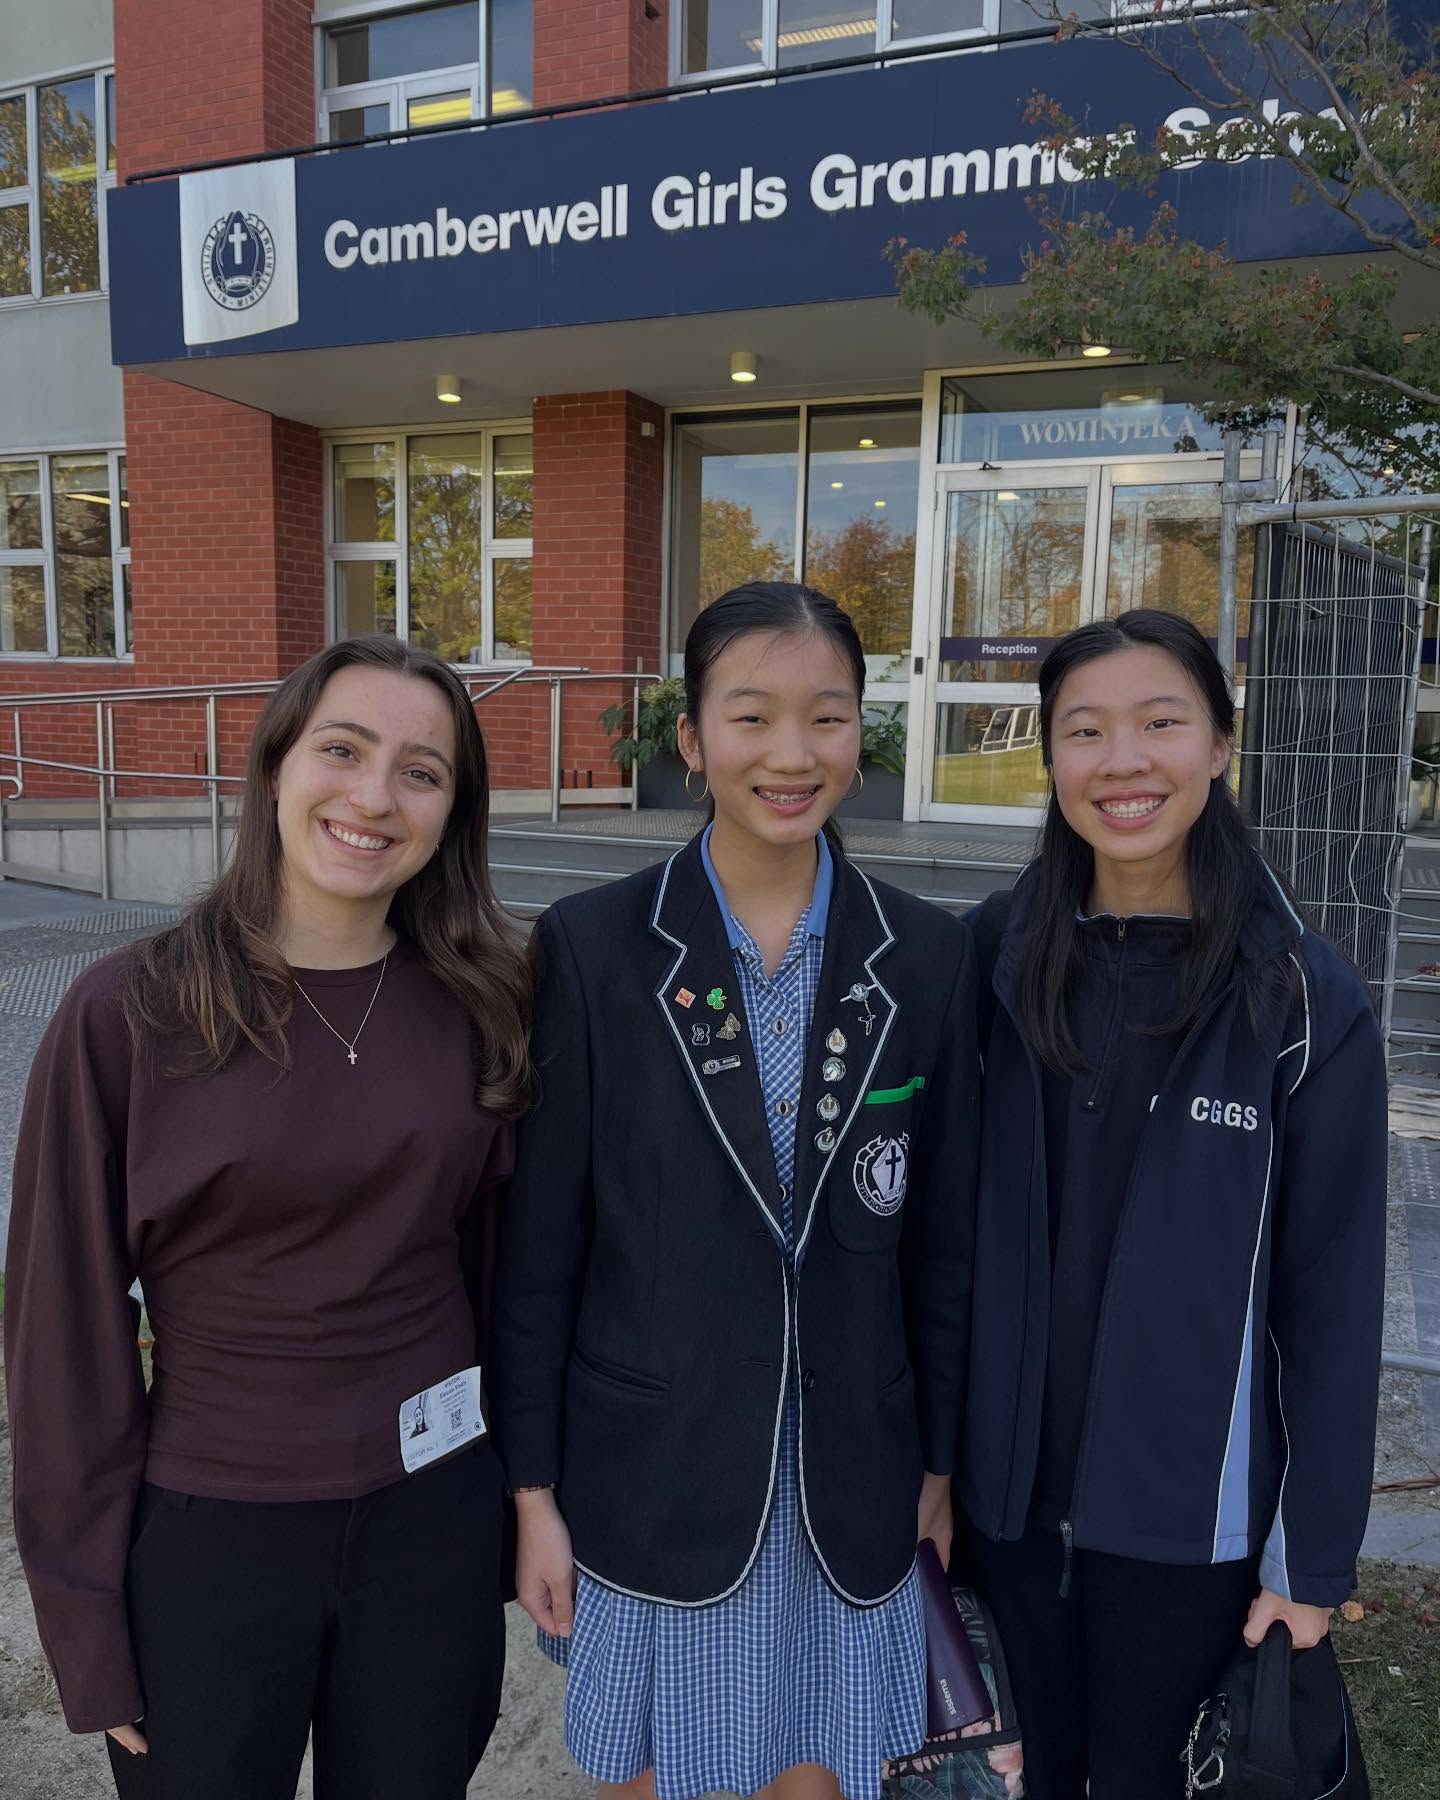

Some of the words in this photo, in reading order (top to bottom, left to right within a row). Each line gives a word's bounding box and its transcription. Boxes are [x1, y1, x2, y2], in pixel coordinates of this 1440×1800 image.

[324, 184, 628, 269] Camberwell
[651, 166, 788, 231] Girls
[1020, 415, 1197, 445] WOMINJEKA
[981, 643, 1038, 656] Reception
[1190, 1096, 1258, 1131] CGGS
[939, 1678, 957, 1715] sistema
